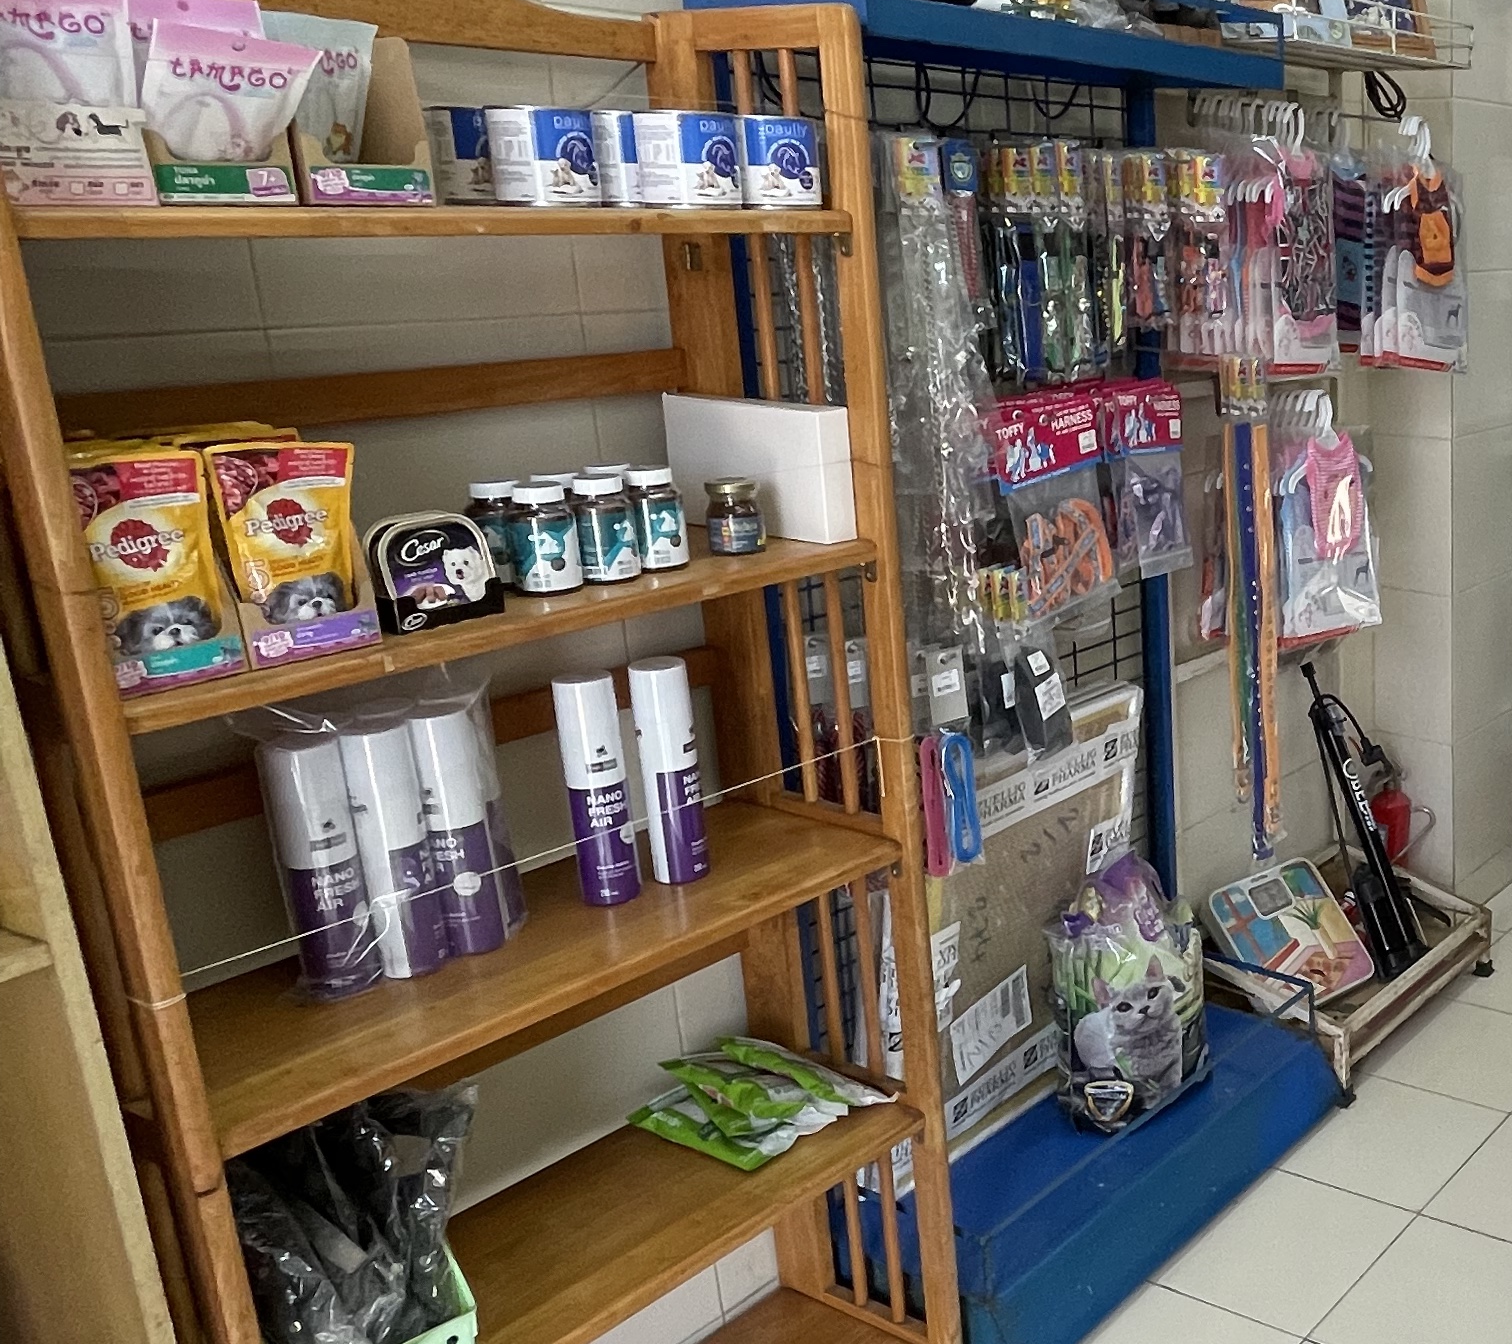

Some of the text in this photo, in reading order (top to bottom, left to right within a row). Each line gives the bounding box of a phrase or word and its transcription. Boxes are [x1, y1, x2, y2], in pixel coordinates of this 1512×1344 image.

[0, 7, 107, 40] MAGO
[995, 422, 1025, 441] TOFFY
[1050, 409, 1093, 432] HARNESS
[244, 509, 328, 538] Pedigree
[89, 527, 185, 562] Pedigree
[401, 537, 444, 562] Cesar
[587, 790, 622, 806] NANO
[590, 816, 613, 828] AIR
[312, 867, 354, 887] NANO
